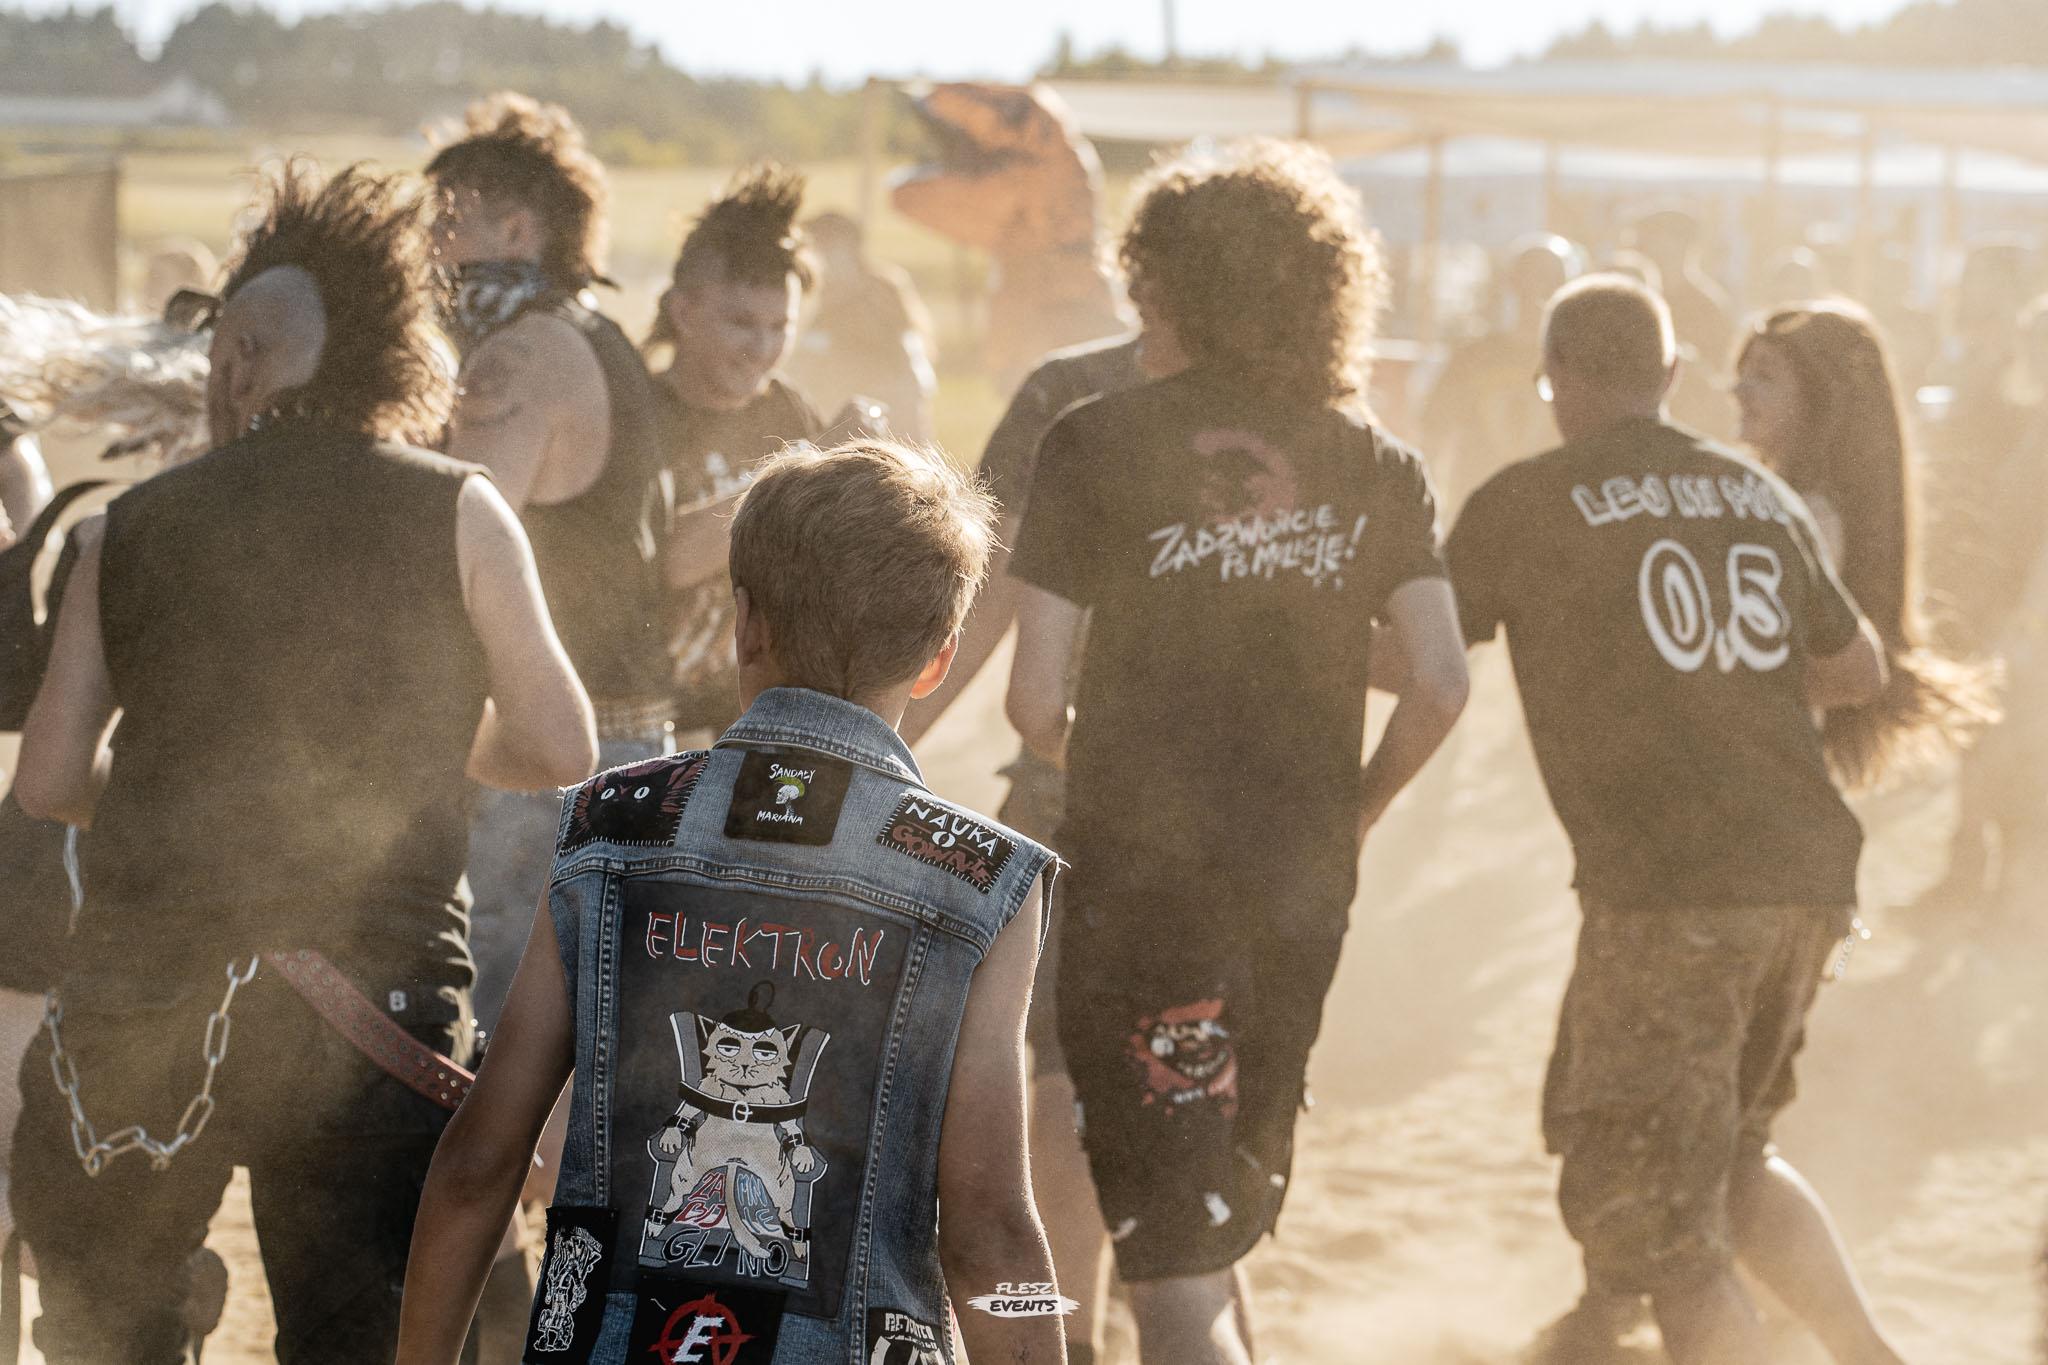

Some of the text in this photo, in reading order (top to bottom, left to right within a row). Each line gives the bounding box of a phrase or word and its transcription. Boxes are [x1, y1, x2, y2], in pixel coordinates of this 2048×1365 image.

[756, 810, 804, 825] MARIANA
[905, 802, 998, 857] NAUKA
[646, 911, 884, 985] ELEKTRON
